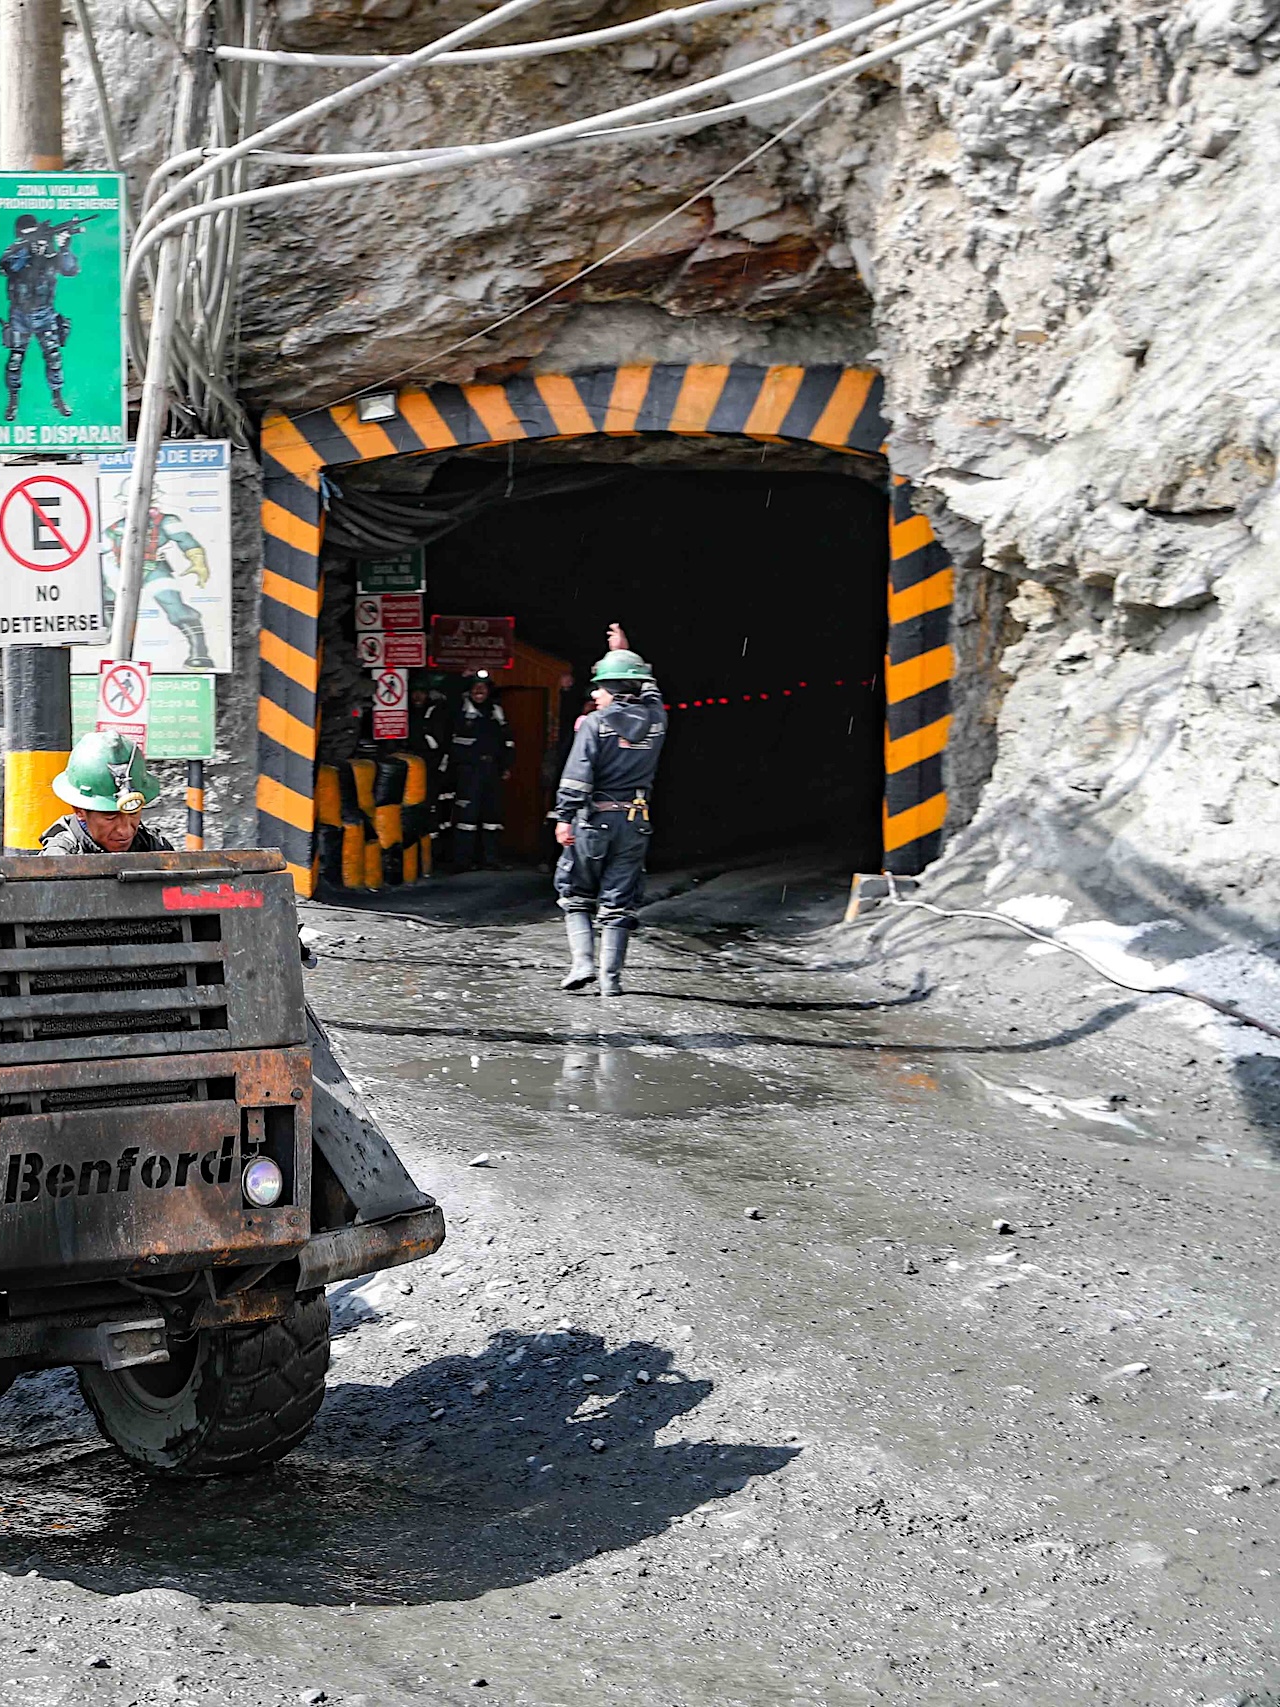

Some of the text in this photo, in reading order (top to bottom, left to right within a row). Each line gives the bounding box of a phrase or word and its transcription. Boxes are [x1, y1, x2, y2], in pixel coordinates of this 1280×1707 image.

[17, 185, 48, 196] ZONA
[57, 198, 119, 209] DETENERSE
[14, 426, 37, 444] DE
[41, 426, 123, 444] DISPARAR
[168, 450, 187, 463] DE
[190, 449, 219, 463] EPP
[36, 585, 60, 601] NO
[0, 614, 99, 634] DETENERSE
[458, 621, 489, 633] ALTO
[151, 681, 200, 692] ISPARO
[5, 1136, 236, 1204] Benford
